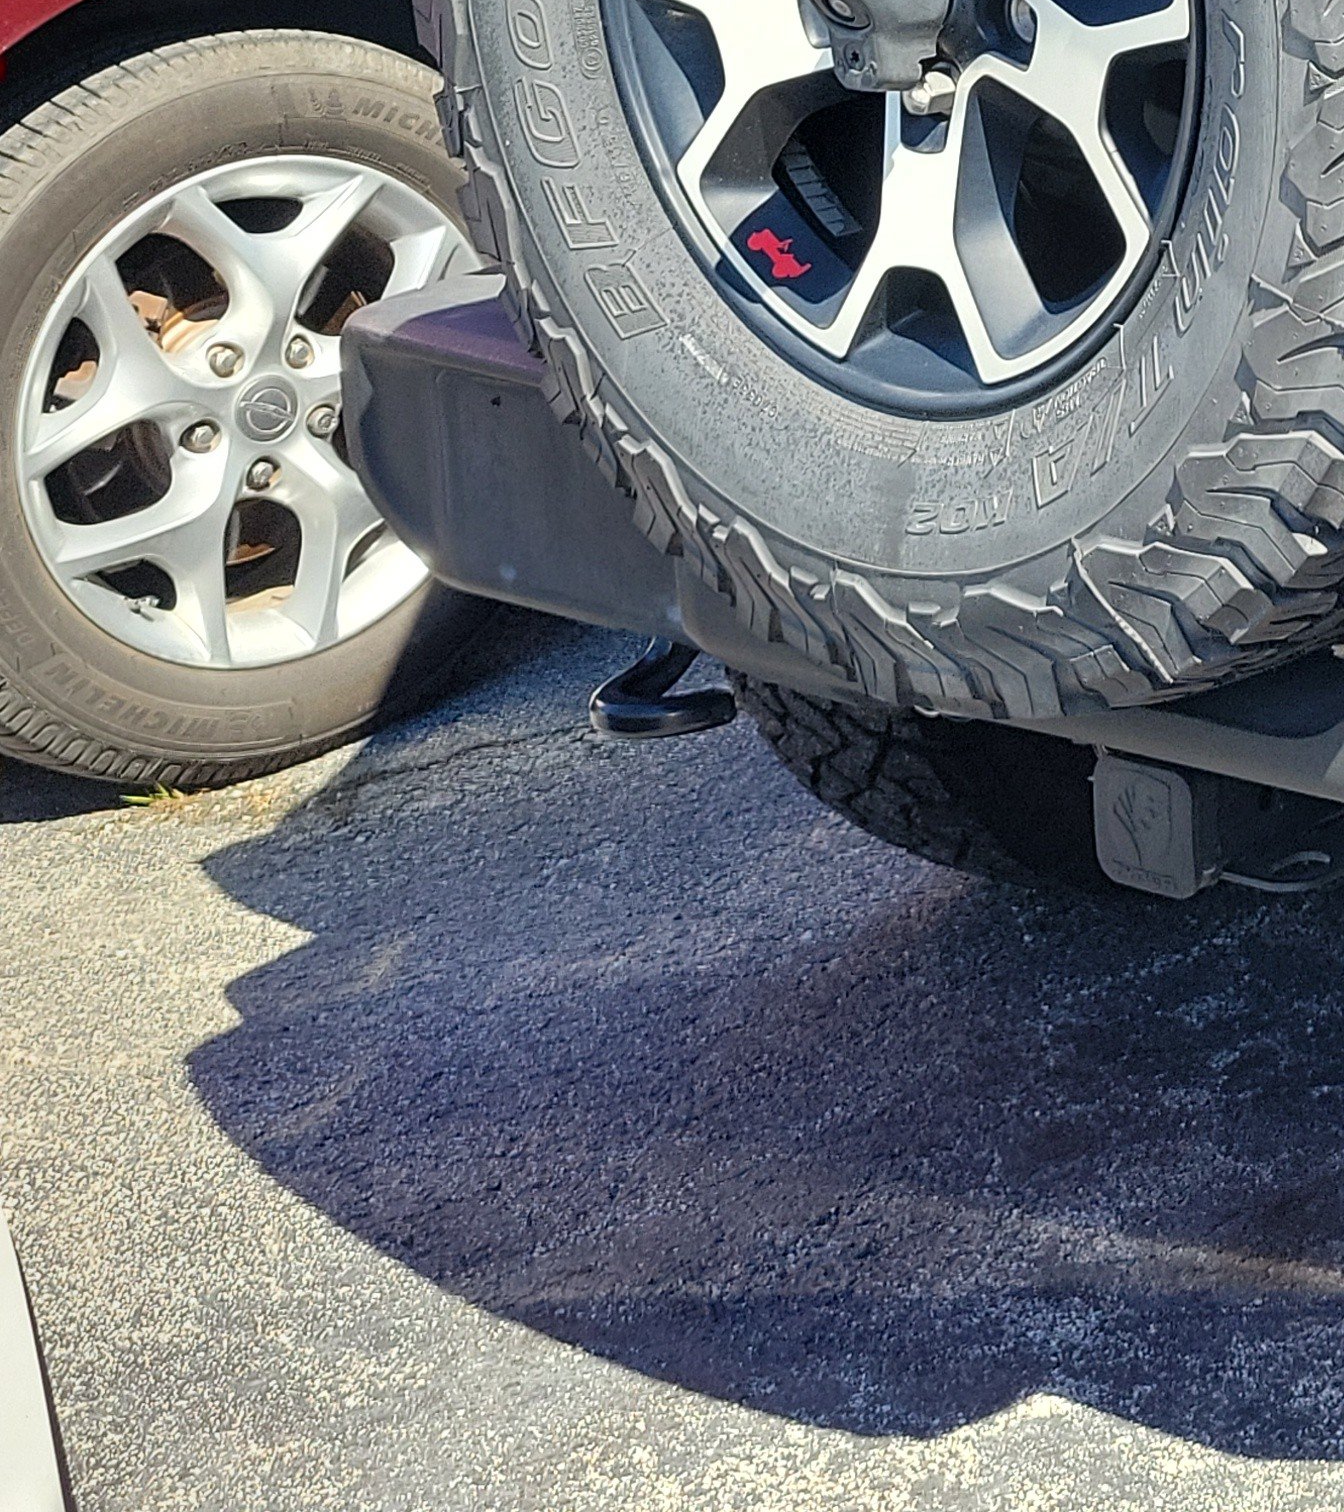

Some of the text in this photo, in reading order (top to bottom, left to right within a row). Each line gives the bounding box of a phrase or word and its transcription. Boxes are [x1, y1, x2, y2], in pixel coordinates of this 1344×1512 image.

[352, 96, 444, 148] MICH
[1031, 334, 1175, 509] T/A
[905, 491, 1014, 536] KO2
[44, 659, 219, 740] MICHELIN
